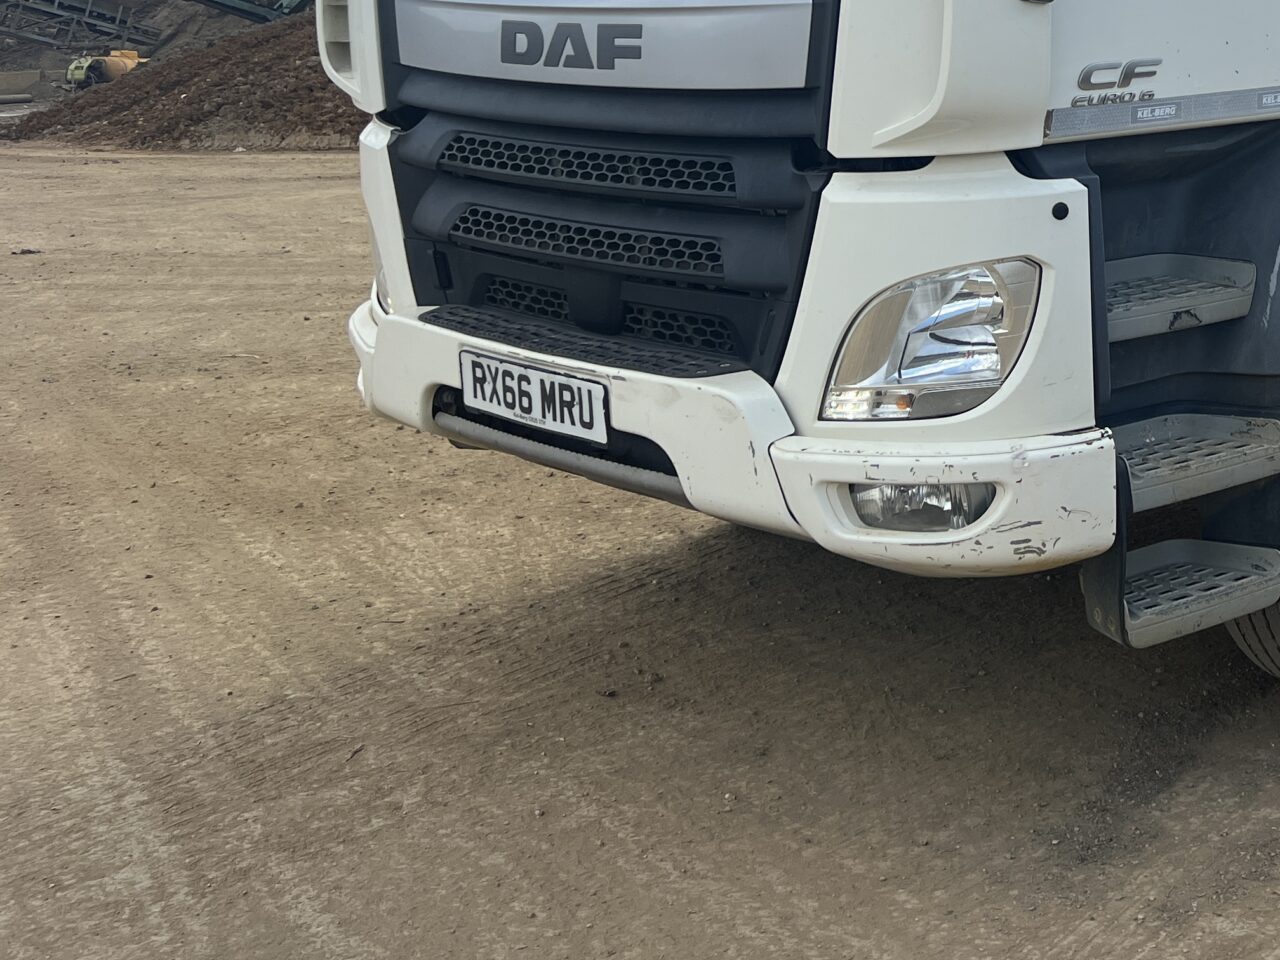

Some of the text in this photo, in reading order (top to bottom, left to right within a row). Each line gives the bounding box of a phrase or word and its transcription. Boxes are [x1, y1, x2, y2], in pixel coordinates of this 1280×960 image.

[500, 19, 643, 70] DAF
[1077, 58, 1163, 91] CF
[1070, 89, 1155, 108] EURO 6
[1137, 106, 1177, 119] KEL-BERG
[471, 360, 595, 431] RX66 MRU
